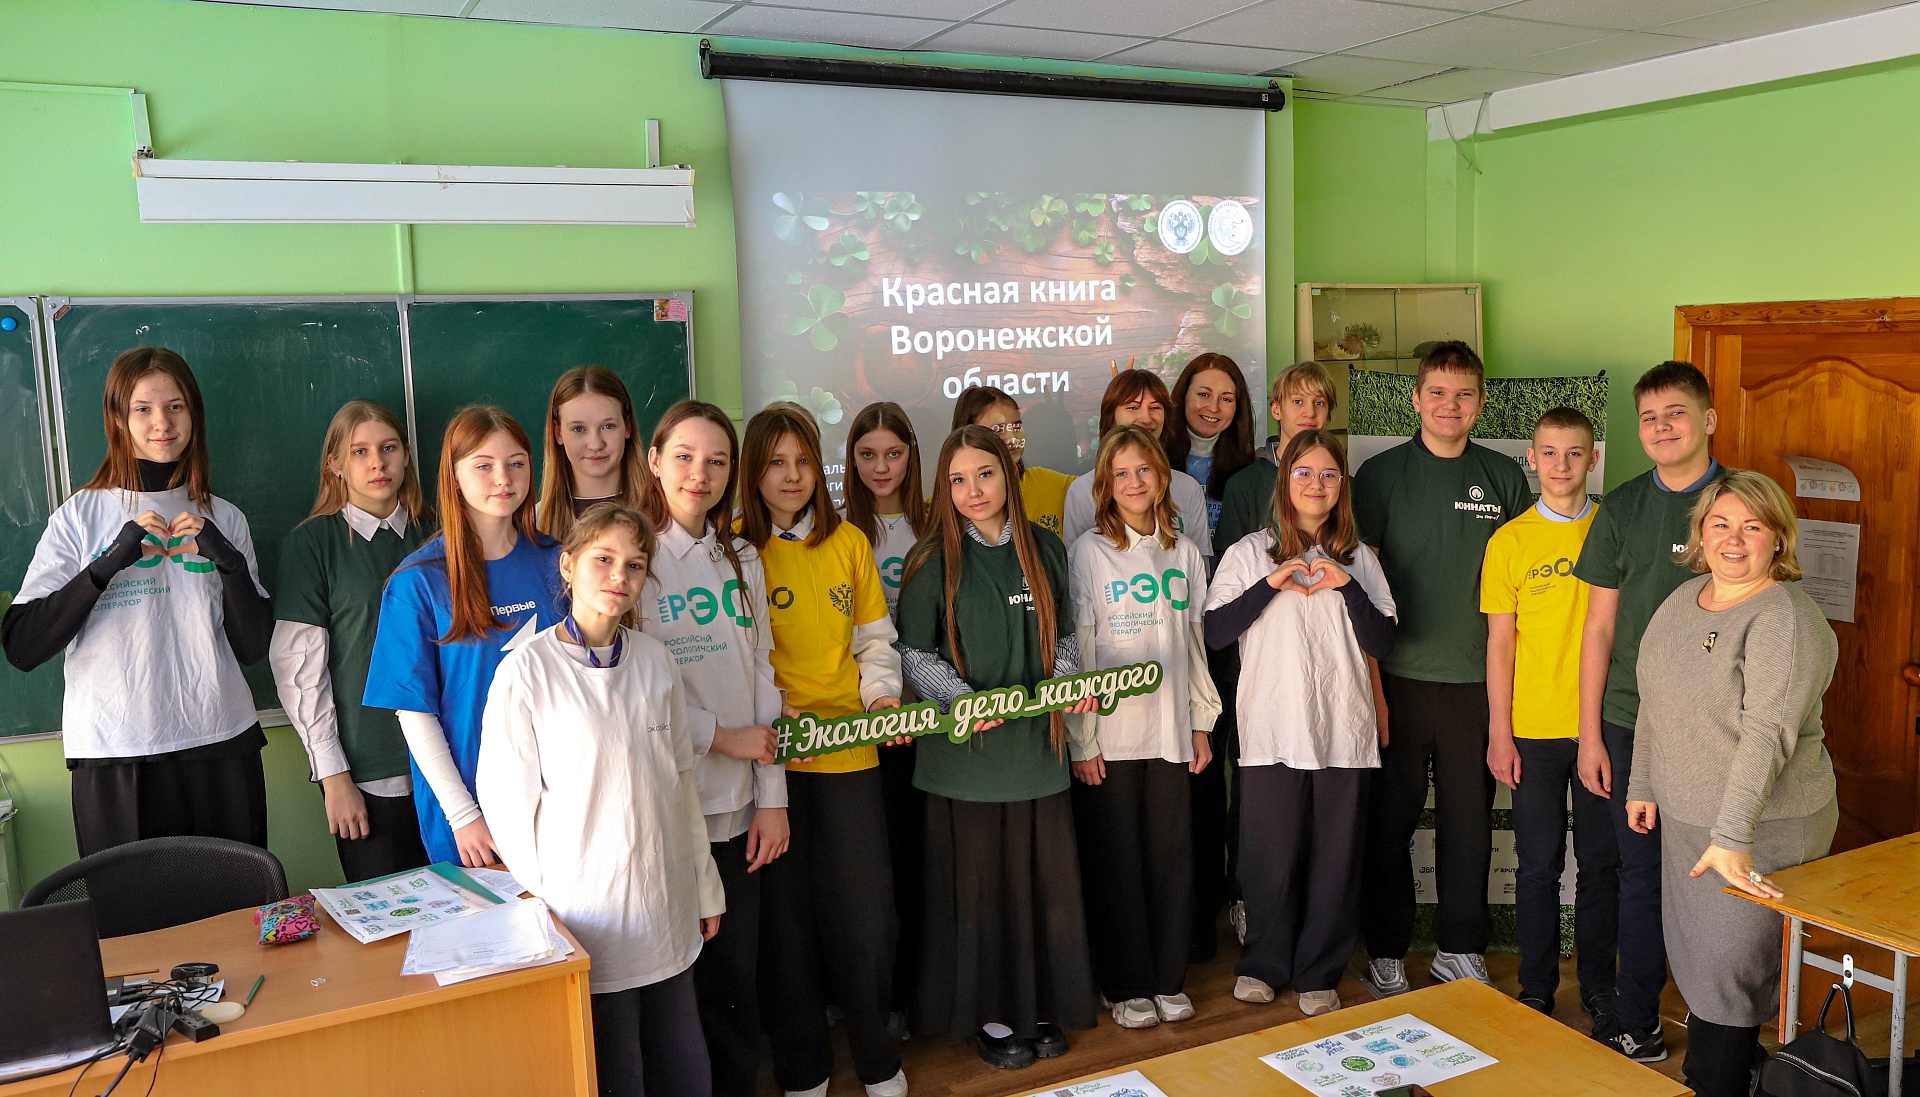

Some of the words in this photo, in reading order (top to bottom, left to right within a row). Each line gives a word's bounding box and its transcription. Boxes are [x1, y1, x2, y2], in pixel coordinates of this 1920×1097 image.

[882, 277, 1019, 314] Красная
[1030, 279, 1116, 303] книга
[891, 316, 1113, 360] Воронежской
[1454, 501, 1501, 514] ЮННАТЫ
[1531, 557, 1574, 579] РЭО
[99, 586, 171, 602] КОЛОГИЧЕСКИЙ
[92, 598, 142, 613] ОПЕРАТОР
[490, 600, 537, 617] Первые
[657, 596, 671, 623] ППК
[774, 707, 940, 758] #Экология
